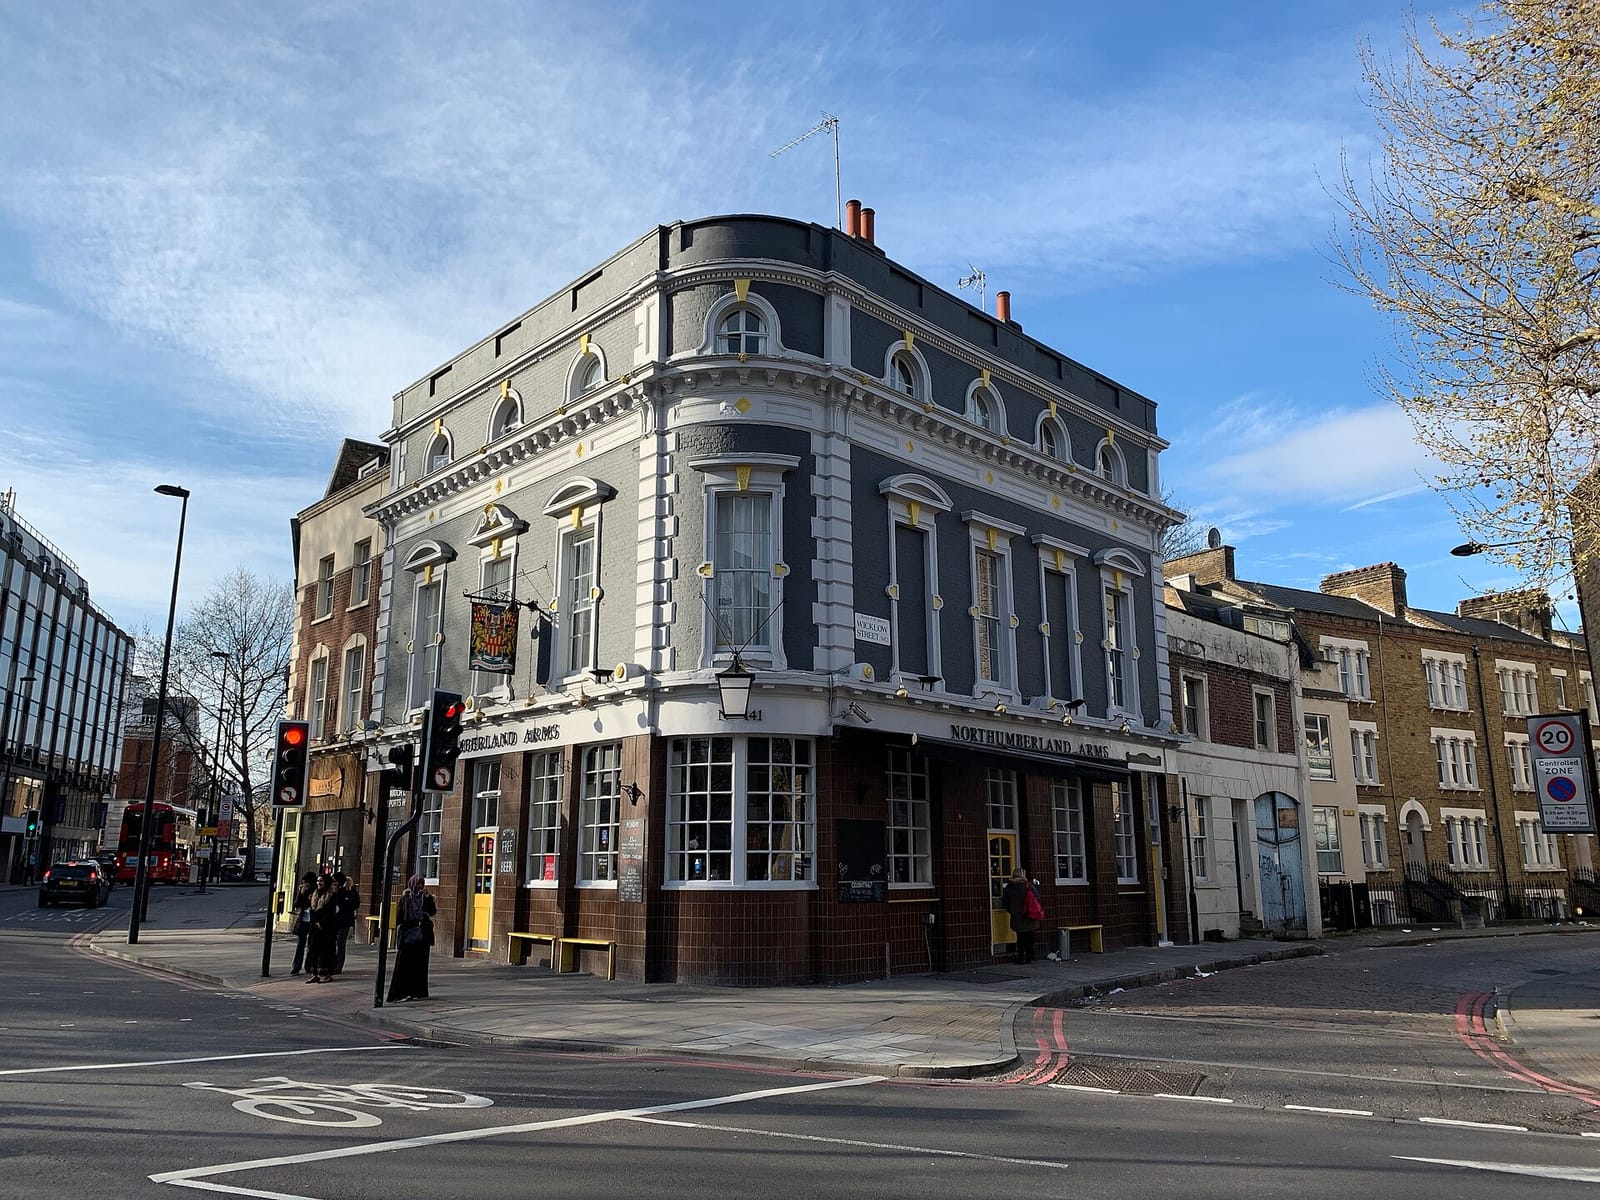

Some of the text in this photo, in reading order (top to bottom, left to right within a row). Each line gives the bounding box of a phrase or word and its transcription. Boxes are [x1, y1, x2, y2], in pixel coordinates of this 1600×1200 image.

[857, 619, 887, 633] WICKLOW
[857, 630, 879, 641] STREET
[524, 724, 561, 744] ARMS
[1542, 730, 1569, 745] 20
[950, 724, 1109, 759] NORTHUMBERLAND ARMS
[1545, 767, 1574, 775] ZONE
[501, 839, 513, 854] FREE
[500, 861, 513, 873] BEER
